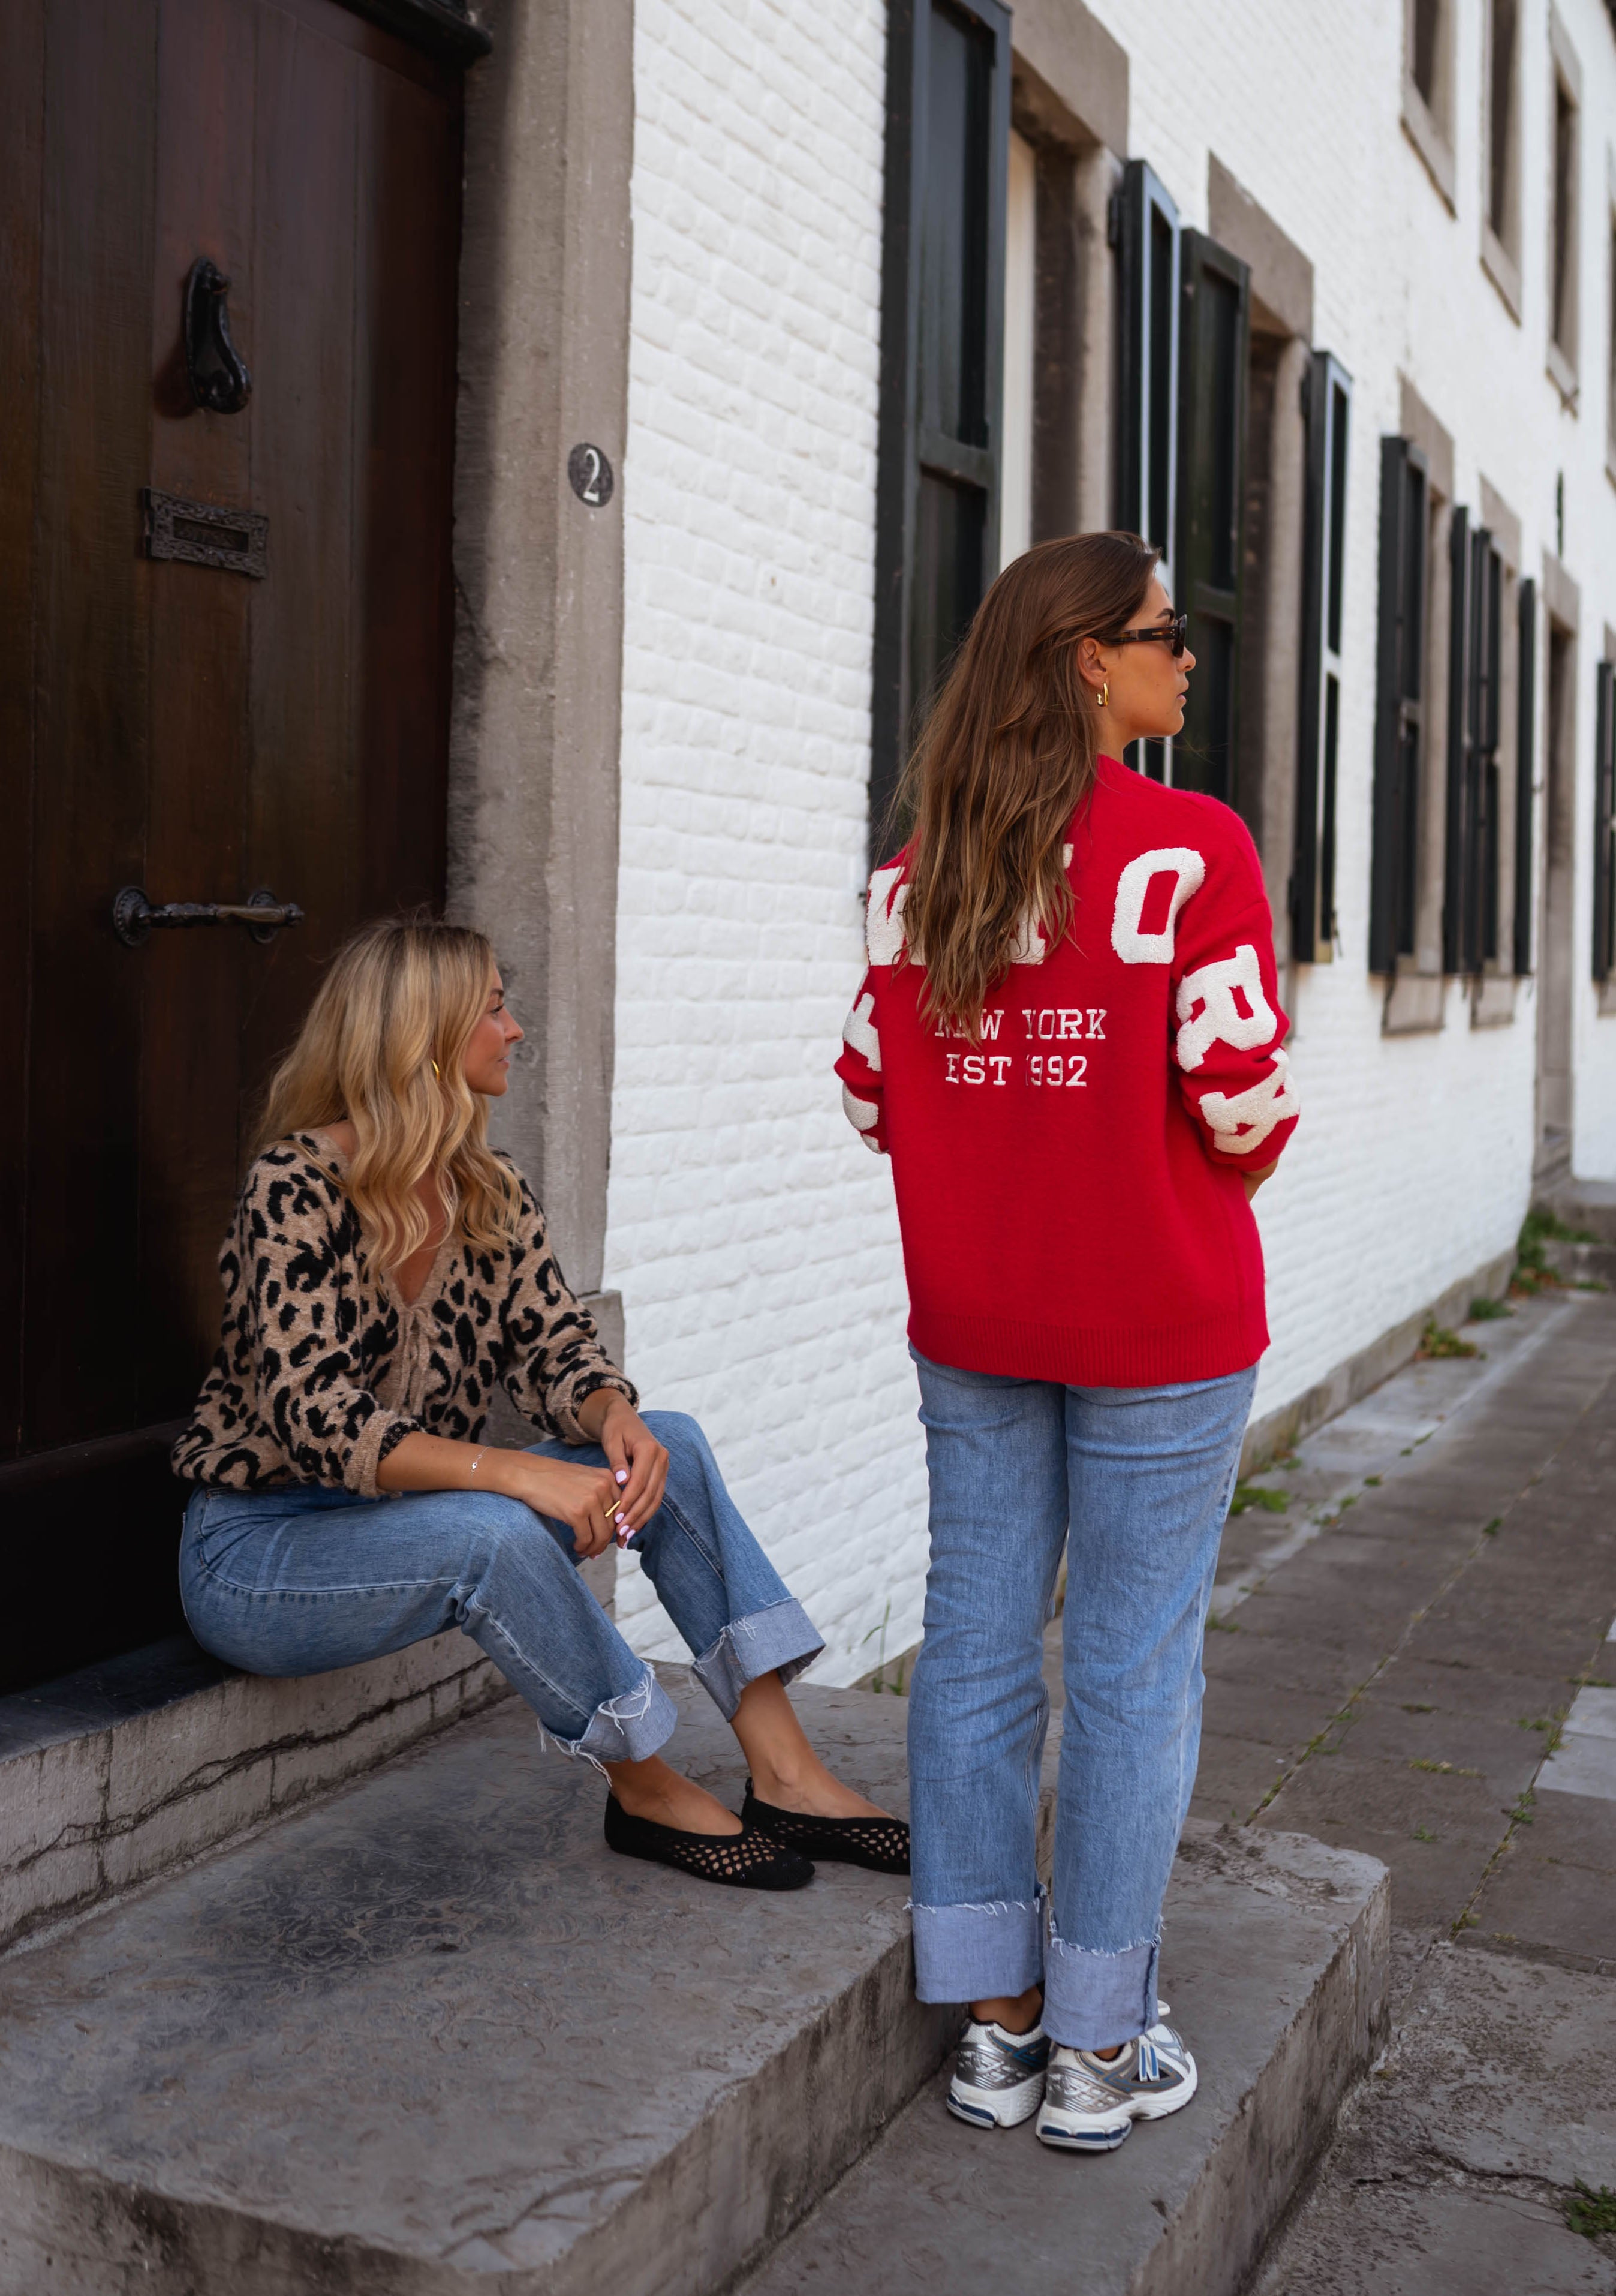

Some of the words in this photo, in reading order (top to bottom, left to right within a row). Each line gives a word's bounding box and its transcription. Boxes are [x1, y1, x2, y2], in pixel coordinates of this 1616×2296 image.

[583, 448, 600, 503] 2
[1022, 1009, 1108, 1039] YORK
[945, 1053, 1012, 1086] EST
[1026, 1054, 1087, 1087] 992
